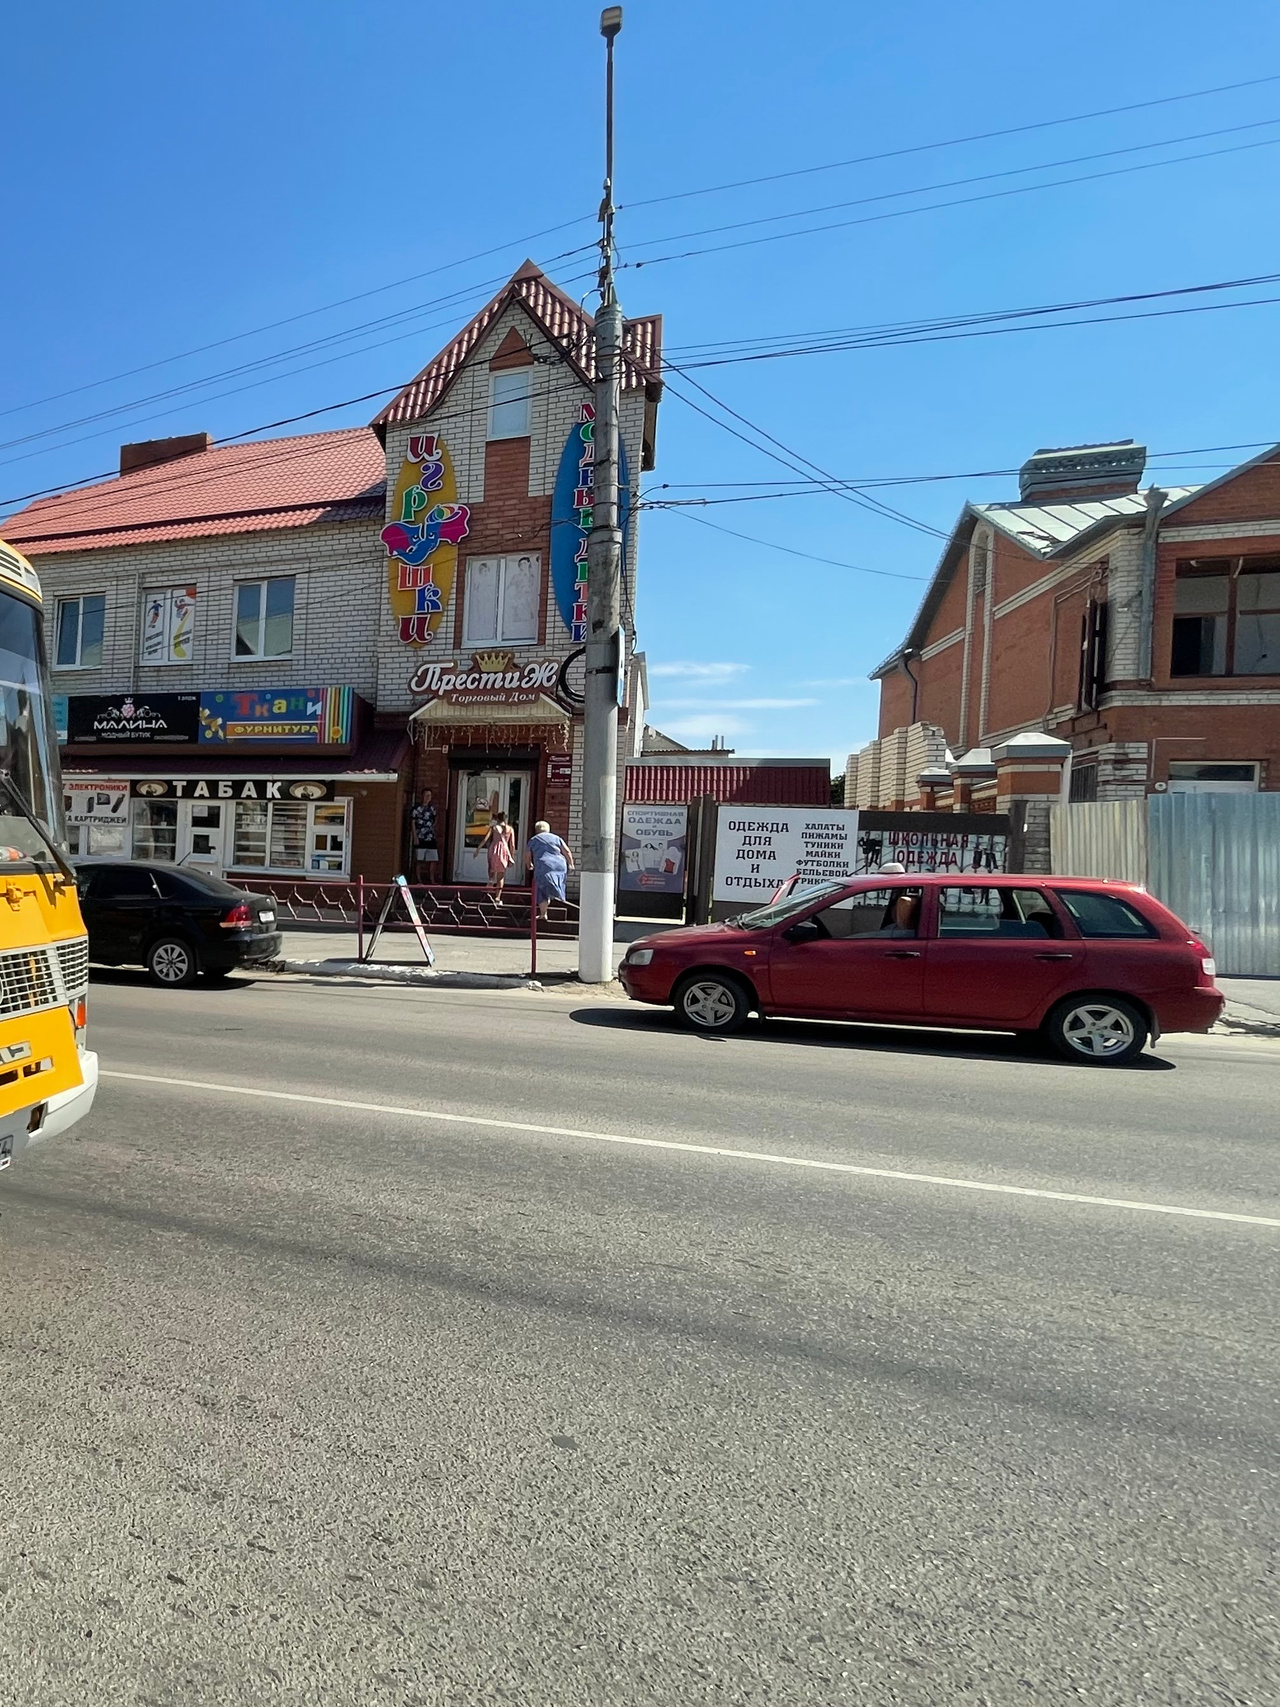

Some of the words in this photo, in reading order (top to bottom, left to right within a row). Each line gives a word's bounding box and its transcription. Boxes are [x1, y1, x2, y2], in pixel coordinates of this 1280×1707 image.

[451, 692, 506, 703] Торговый
[509, 691, 536, 702] Дом
[93, 719, 168, 730] МАЛИНА
[234, 725, 319, 734] ФУРНИТУРА
[68, 783, 128, 792] ЭЛЕКТРОНИКИ
[172, 781, 282, 799] ТАБАК
[628, 817, 682, 825] ОДЕЖДА
[728, 821, 790, 833] ОДЕЖДА
[804, 823, 845, 831] ХАЛАТЫ
[635, 828, 674, 837] ОБУВЬ
[801, 832, 848, 840] ПИЖАМЫ
[742, 835, 772, 846] ДЛЯ
[888, 831, 969, 847] ШКОЛЬНАЯ
[804, 841, 844, 849] ТУНИКИ
[736, 849, 777, 860] ДОМА
[805, 850, 841, 858] МАЙКИ
[896, 850, 958, 867] ОДЕЖДА
[795, 859, 849, 868] ФУТБОЛКИ
[750, 863, 760, 874] И
[796, 868, 849, 877] БЕЛЬЕВОЙ
